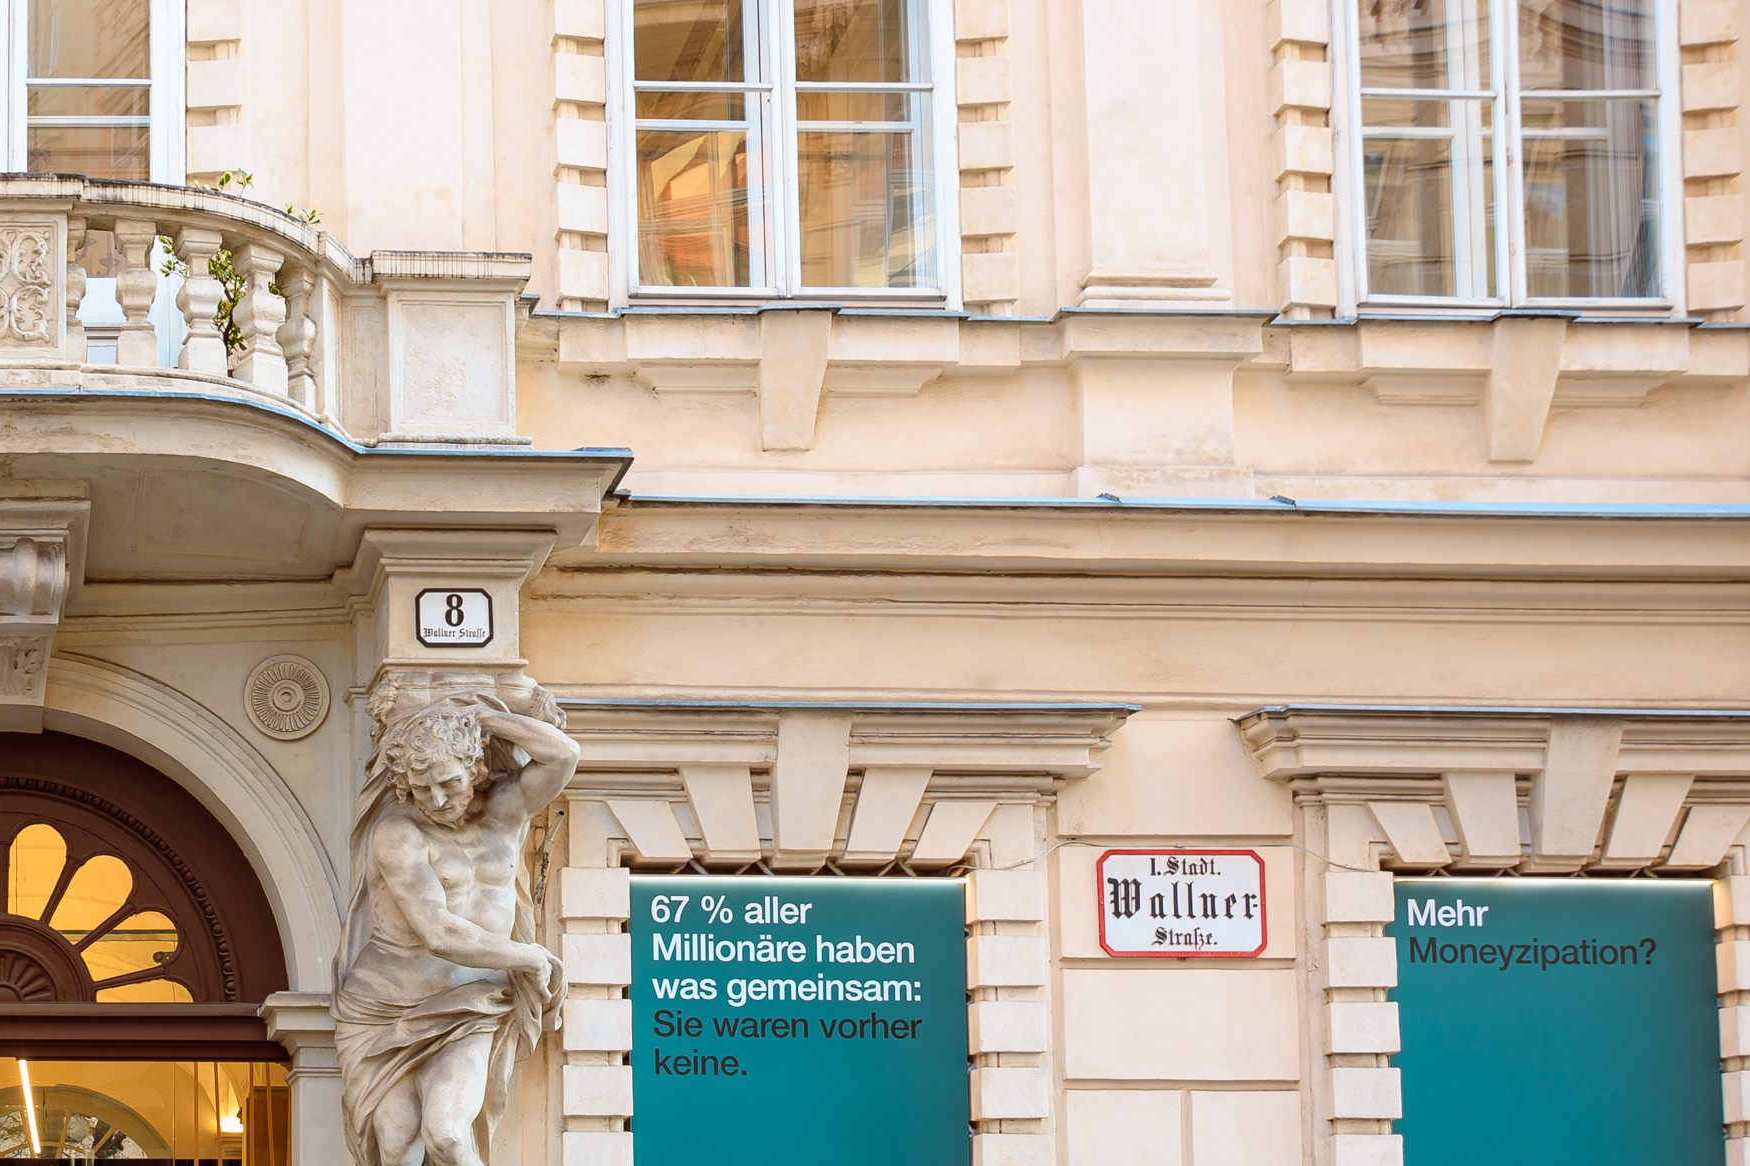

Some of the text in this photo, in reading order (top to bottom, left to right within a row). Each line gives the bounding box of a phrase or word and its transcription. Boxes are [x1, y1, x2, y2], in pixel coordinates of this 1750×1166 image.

[445, 593, 464, 627] 8
[423, 628, 456, 638] Wallner
[650, 894, 813, 925] 67 % aller
[1107, 876, 1259, 920] Wallner-
[1407, 898, 1489, 927] Mehr
[652, 932, 915, 964] Millionäre haben
[1151, 926, 1219, 951] Straße.
[1409, 936, 1657, 972] Moneyzipation?
[651, 972, 921, 1008] was gemeinsam:
[653, 1009, 923, 1040] Sie waren vorher
[654, 1048, 748, 1077] keine.
